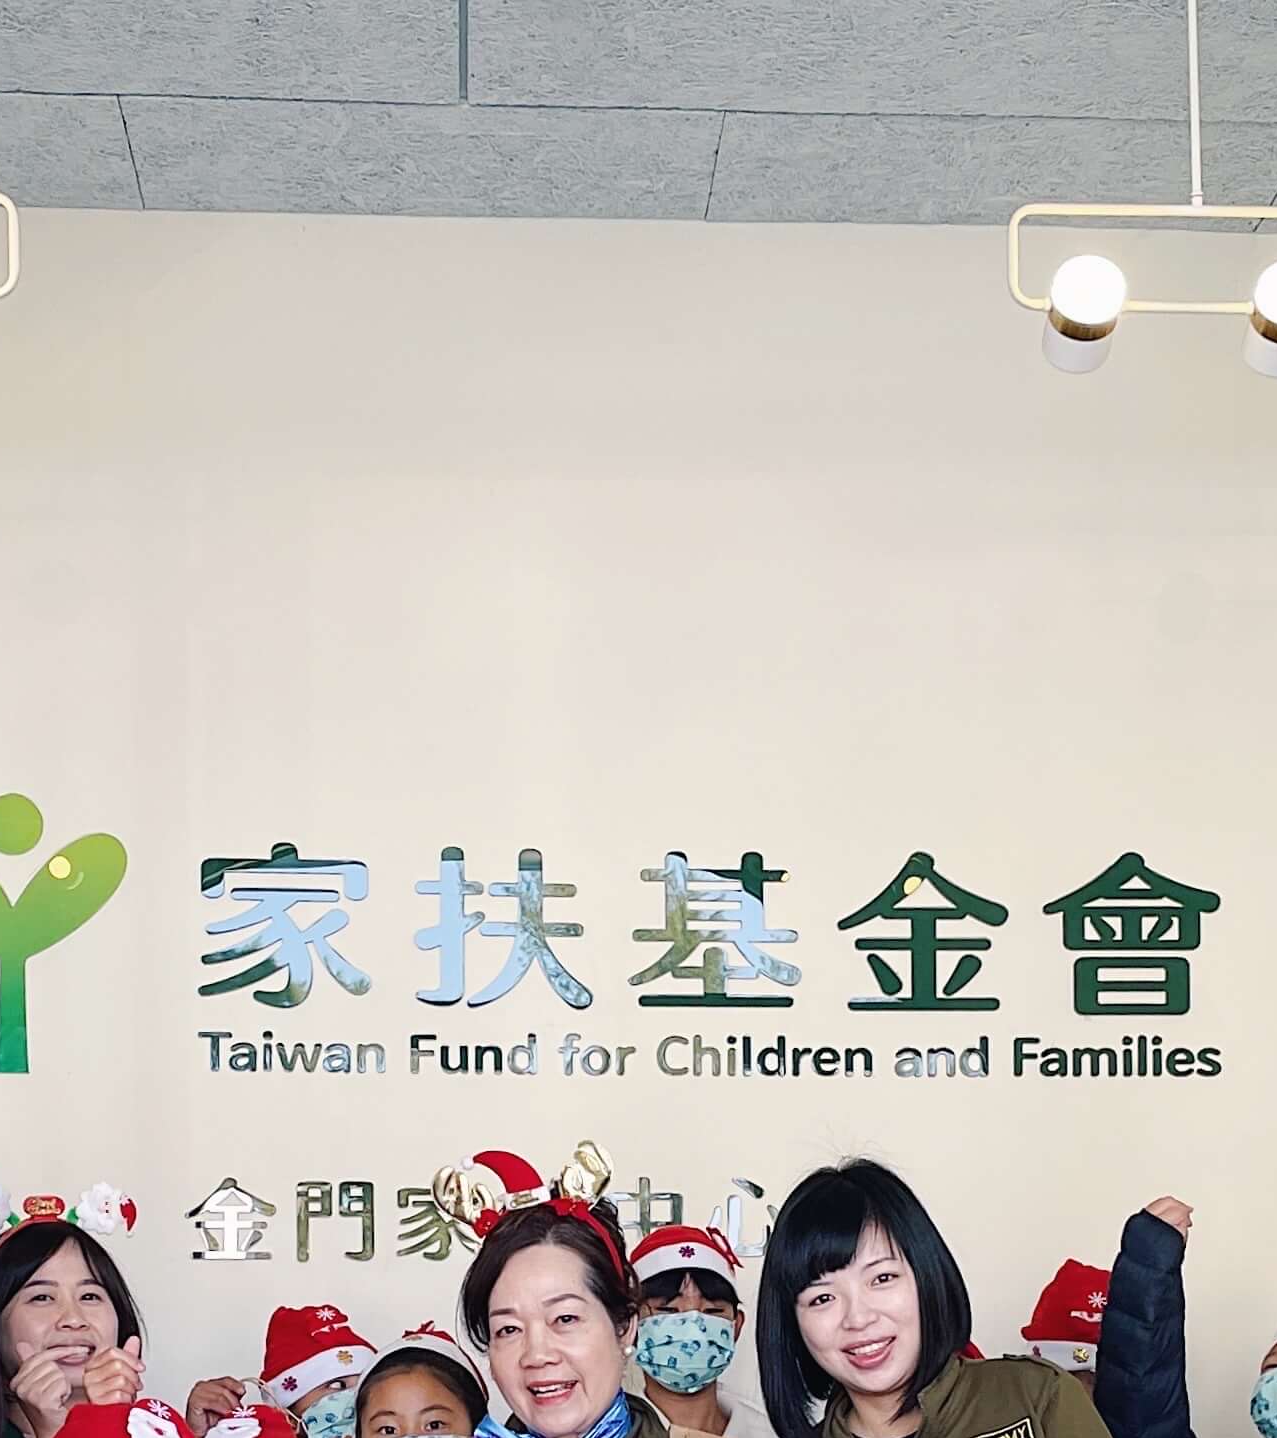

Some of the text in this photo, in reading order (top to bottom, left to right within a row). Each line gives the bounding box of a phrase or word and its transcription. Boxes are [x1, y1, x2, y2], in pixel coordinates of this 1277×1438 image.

[197, 842, 1221, 1016] 家扶基金會
[198, 1031, 1222, 1078] Taiwan Fund for Children and Families
